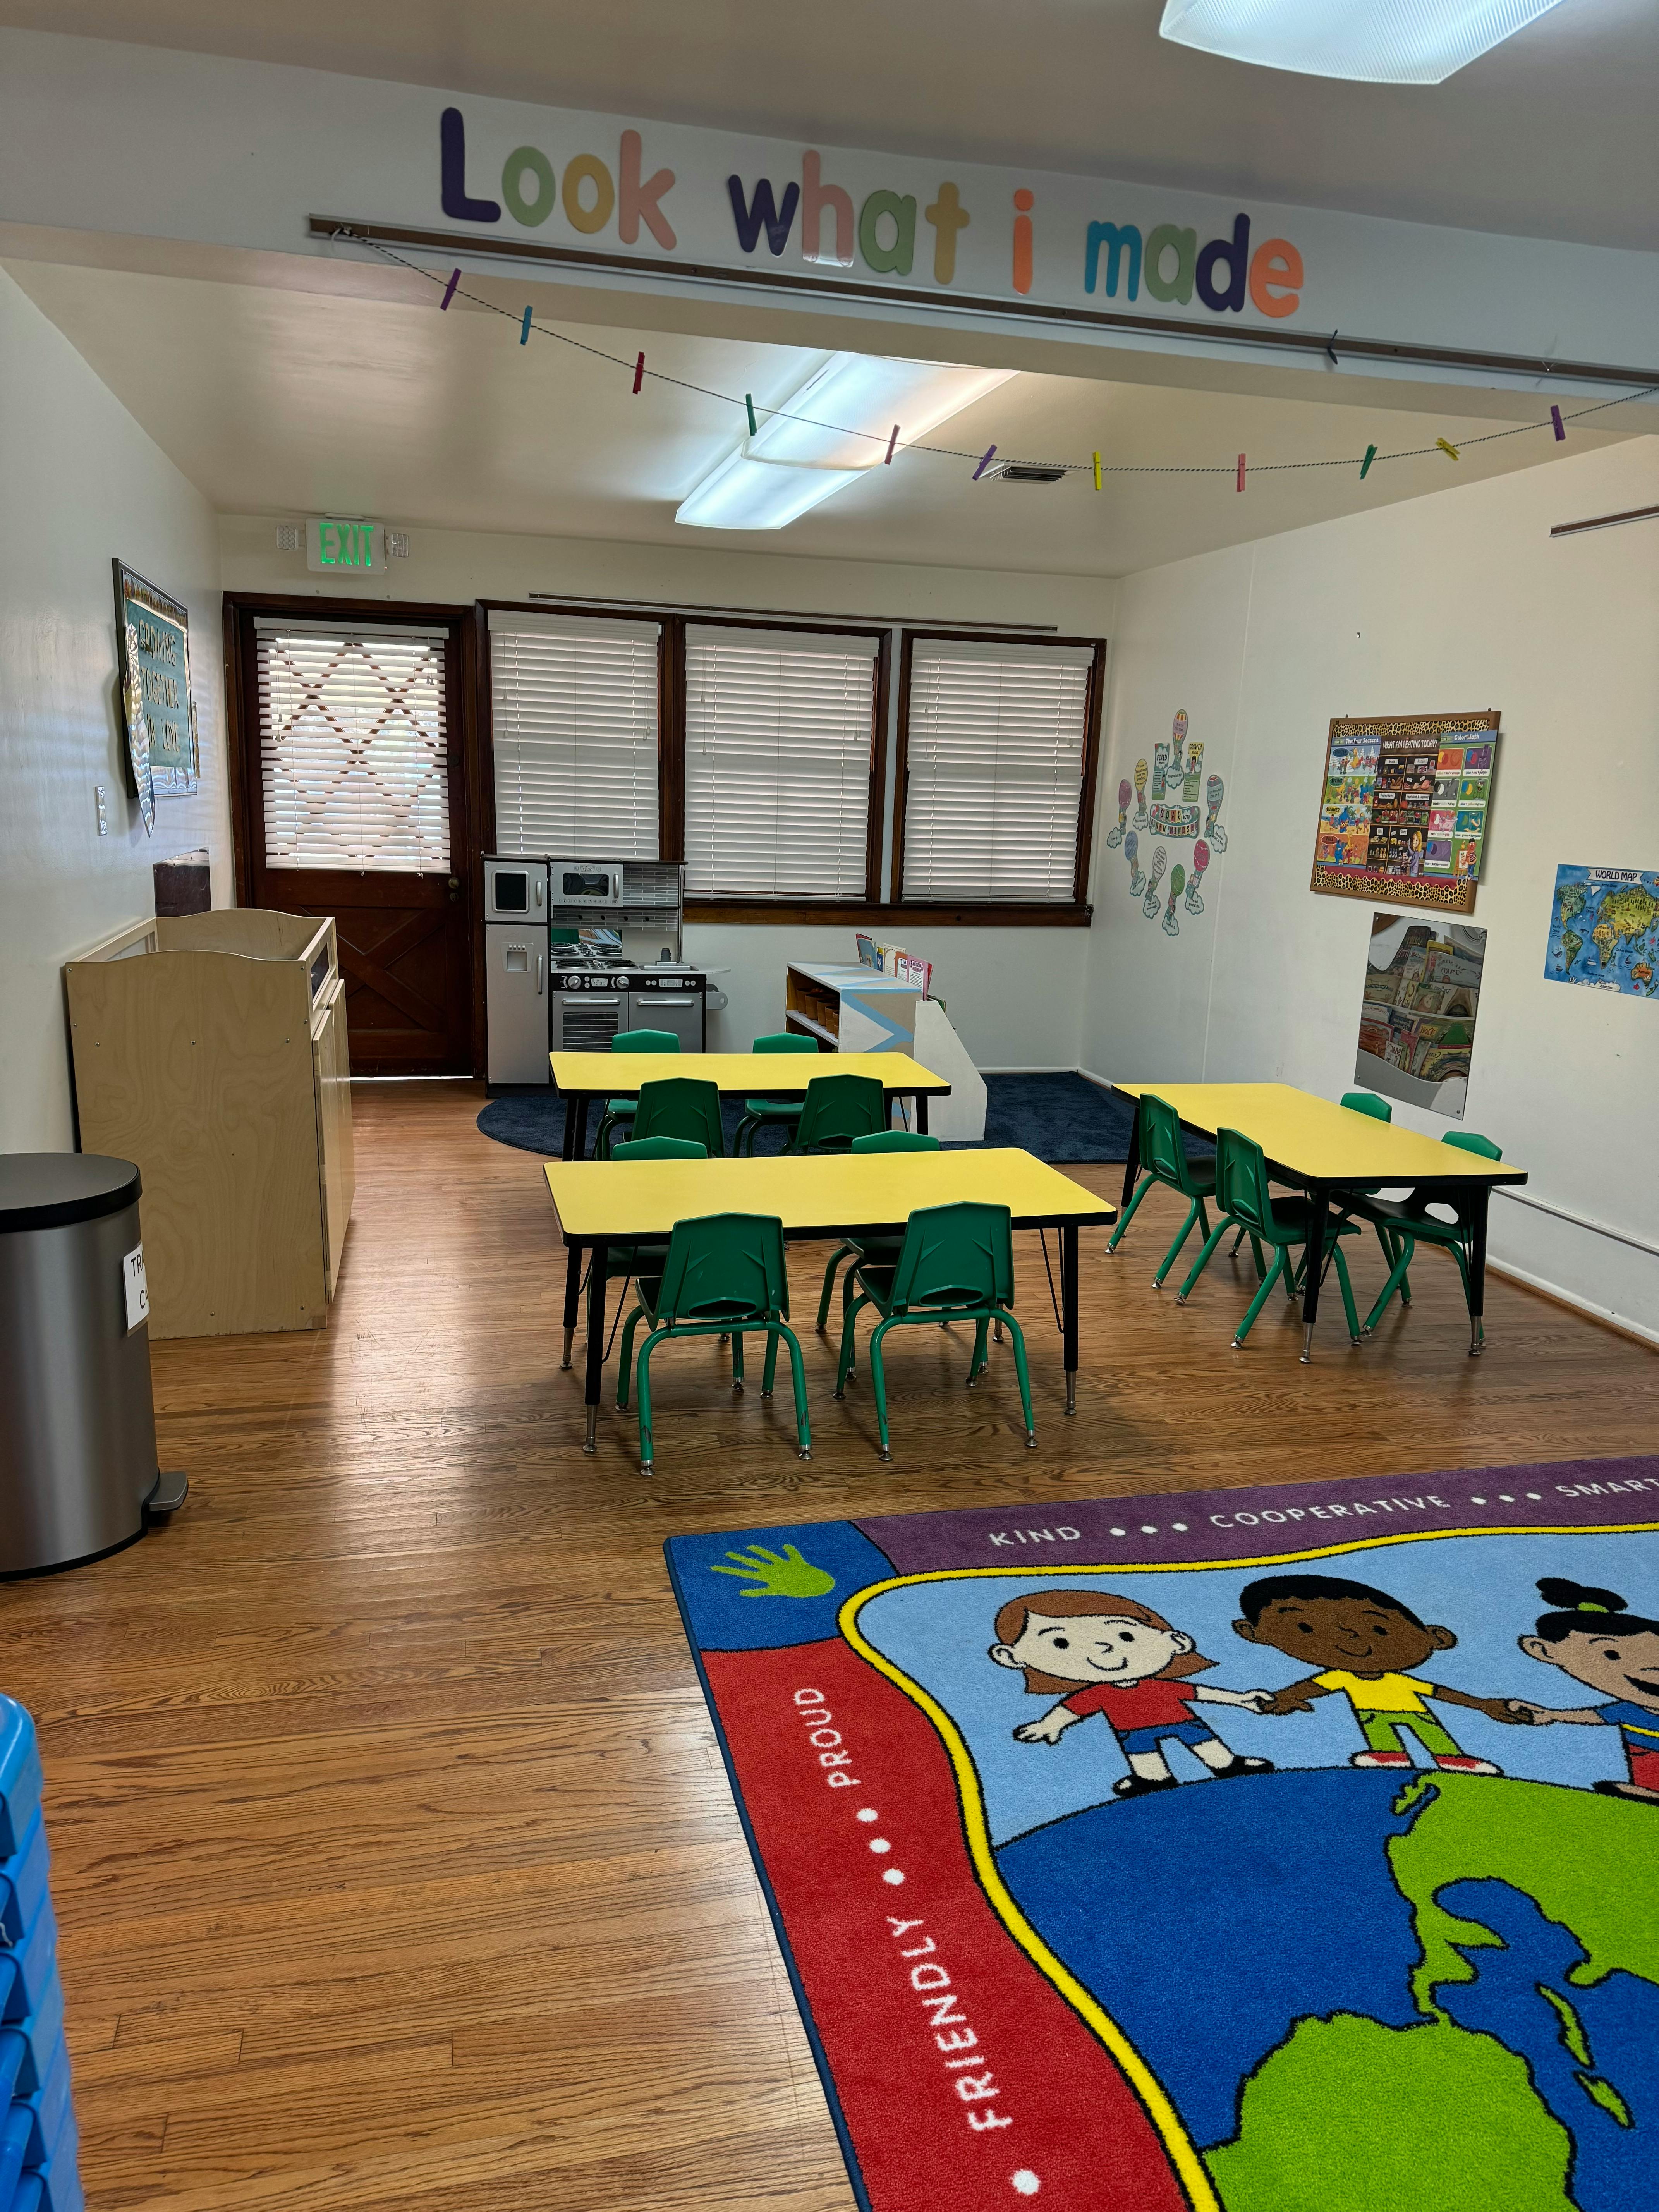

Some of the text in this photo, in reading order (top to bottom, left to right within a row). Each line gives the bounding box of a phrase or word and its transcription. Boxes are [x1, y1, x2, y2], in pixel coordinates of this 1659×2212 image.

[441, 107, 1304, 318] Look what i made
[319, 522, 374, 566] EXIT
[139, 618, 177, 666] GROWING
[140, 665, 179, 709] TOGETHER
[161, 718, 181, 752] LOVE
[1383, 740, 1395, 749] WHAT
[1395, 740, 1403, 749] AM
[1405, 740, 1420, 748] EATING
[1421, 739, 1438, 748] TODAY?
[1160, 809, 1181, 820] SOAR
[1595, 870, 1637, 881] WORLD MAP
[988, 1477, 1659, 1546] KIND COOPERATIVE SMART
[794, 1688, 862, 1789] PROUD
[887, 1914, 1013, 2132] FRIENDLY
